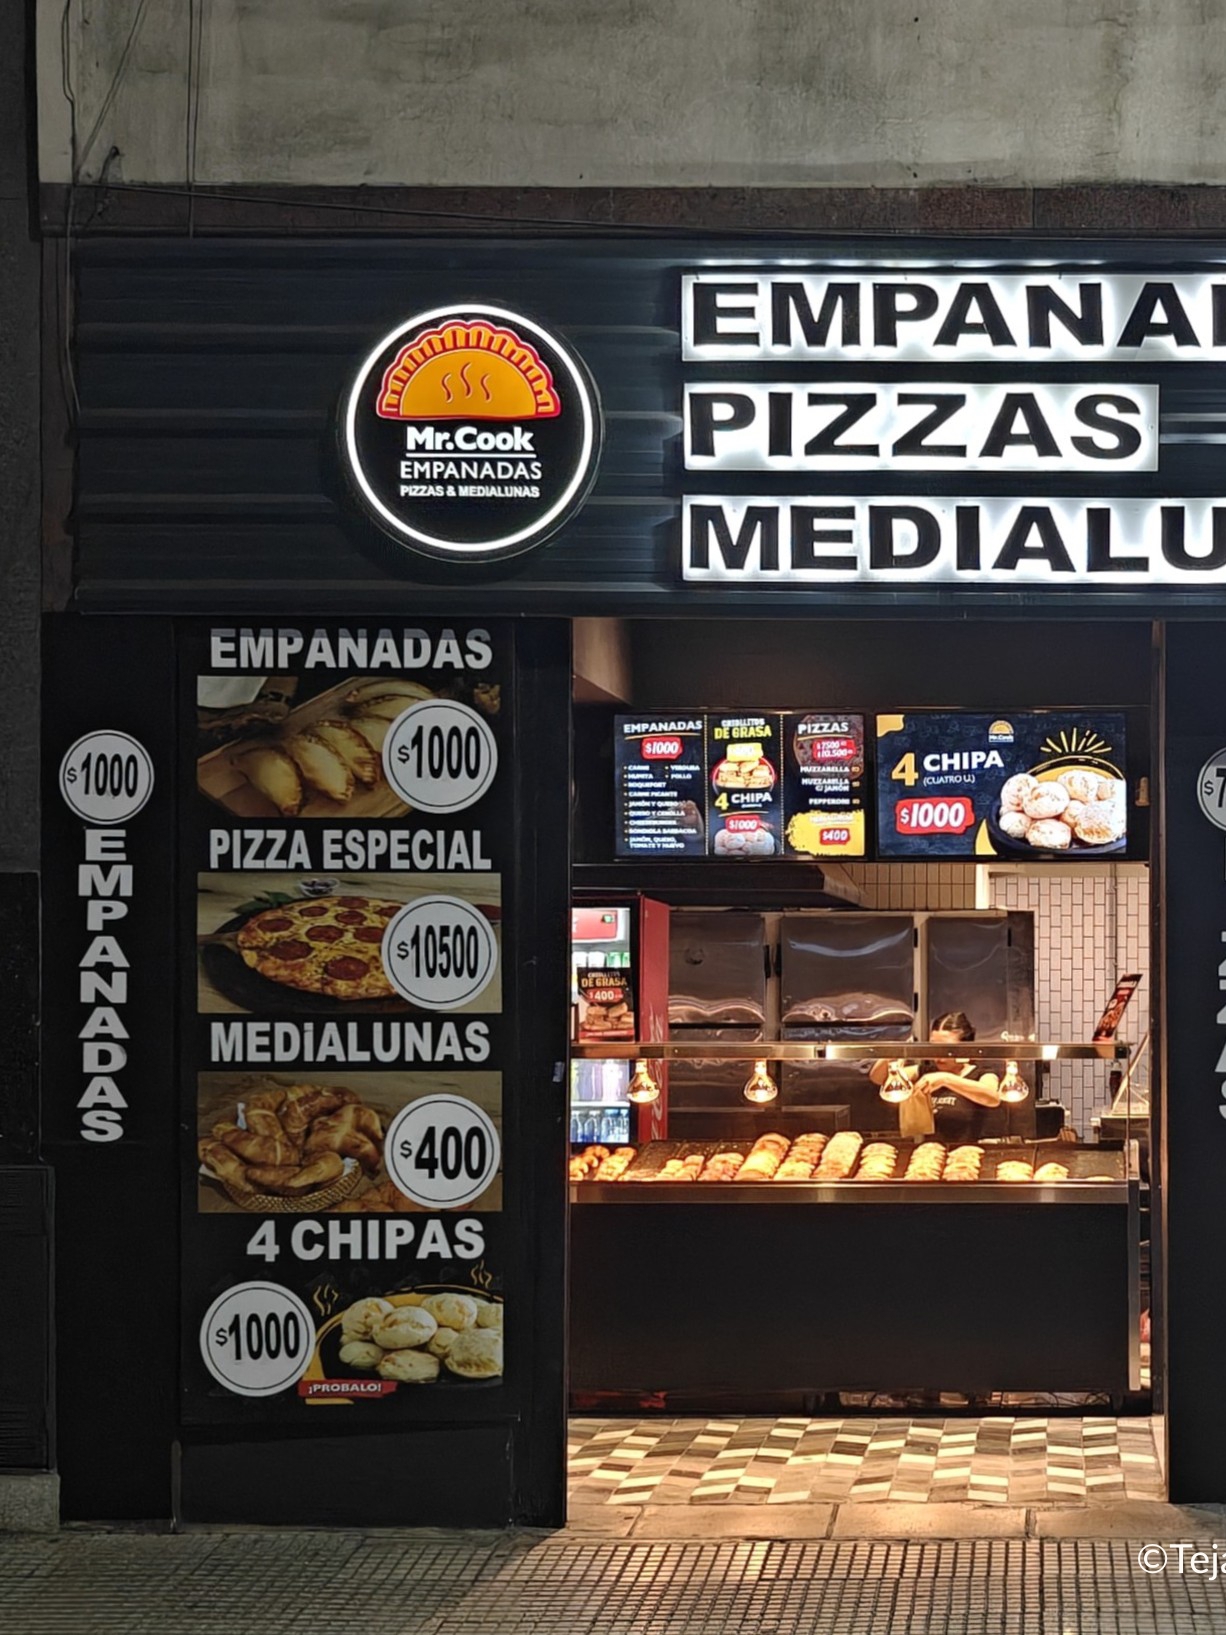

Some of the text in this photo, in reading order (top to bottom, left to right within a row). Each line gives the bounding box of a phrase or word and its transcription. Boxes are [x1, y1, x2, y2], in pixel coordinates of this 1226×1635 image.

[406, 426, 535, 451] Mr.Cook
[689, 392, 1142, 459] PIZZAS
[400, 461, 542, 480] EMPANADAS
[400, 485, 540, 498] PIZZAS & MEDIALUNAS
[210, 628, 493, 669] EMPANADAS
[623, 720, 703, 733] EMPANADAS
[714, 725, 772, 739] DE GRASA
[798, 722, 849, 734] PIZZAS
[397, 725, 481, 780] $1000
[645, 742, 679, 754] $1000
[66, 752, 139, 798] $1000
[891, 750, 1004, 786] 4 CHIPA
[714, 792, 773, 811] 4 CHIPA
[900, 803, 965, 828] $1000
[209, 829, 492, 870] PIZZA ESPECIAL
[397, 924, 479, 979] $10500
[77, 829, 133, 1142] EMPANADAS
[581, 977, 628, 987] DE GRASA
[211, 1021, 491, 1062] MEDIALUNAS
[400, 1126, 487, 1180] $400
[246, 1219, 485, 1262] 4 CHIPAS
[215, 1310, 300, 1361] $1000
[308, 1383, 382, 1394] ¡PROBALO!
